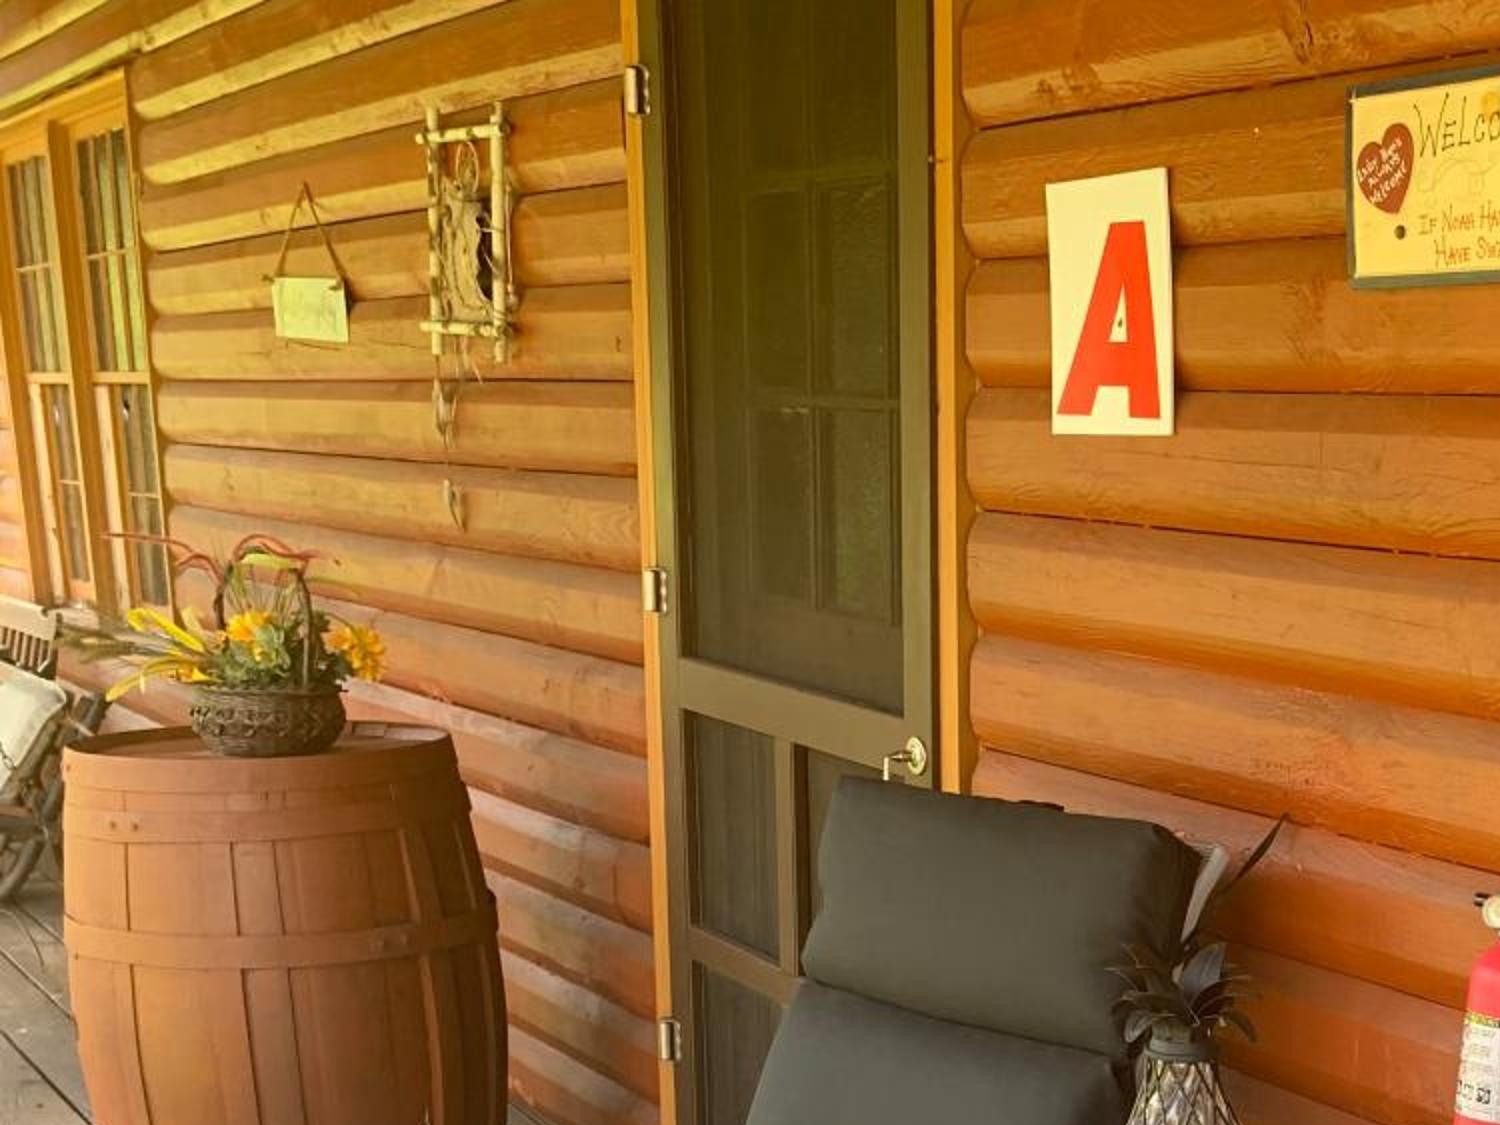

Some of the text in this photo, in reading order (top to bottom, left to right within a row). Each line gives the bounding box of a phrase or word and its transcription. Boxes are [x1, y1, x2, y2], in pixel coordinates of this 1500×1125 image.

[1418, 213, 1437, 235] IF
[1433, 234, 1471, 267] HAVE
[1057, 220, 1161, 419] A
